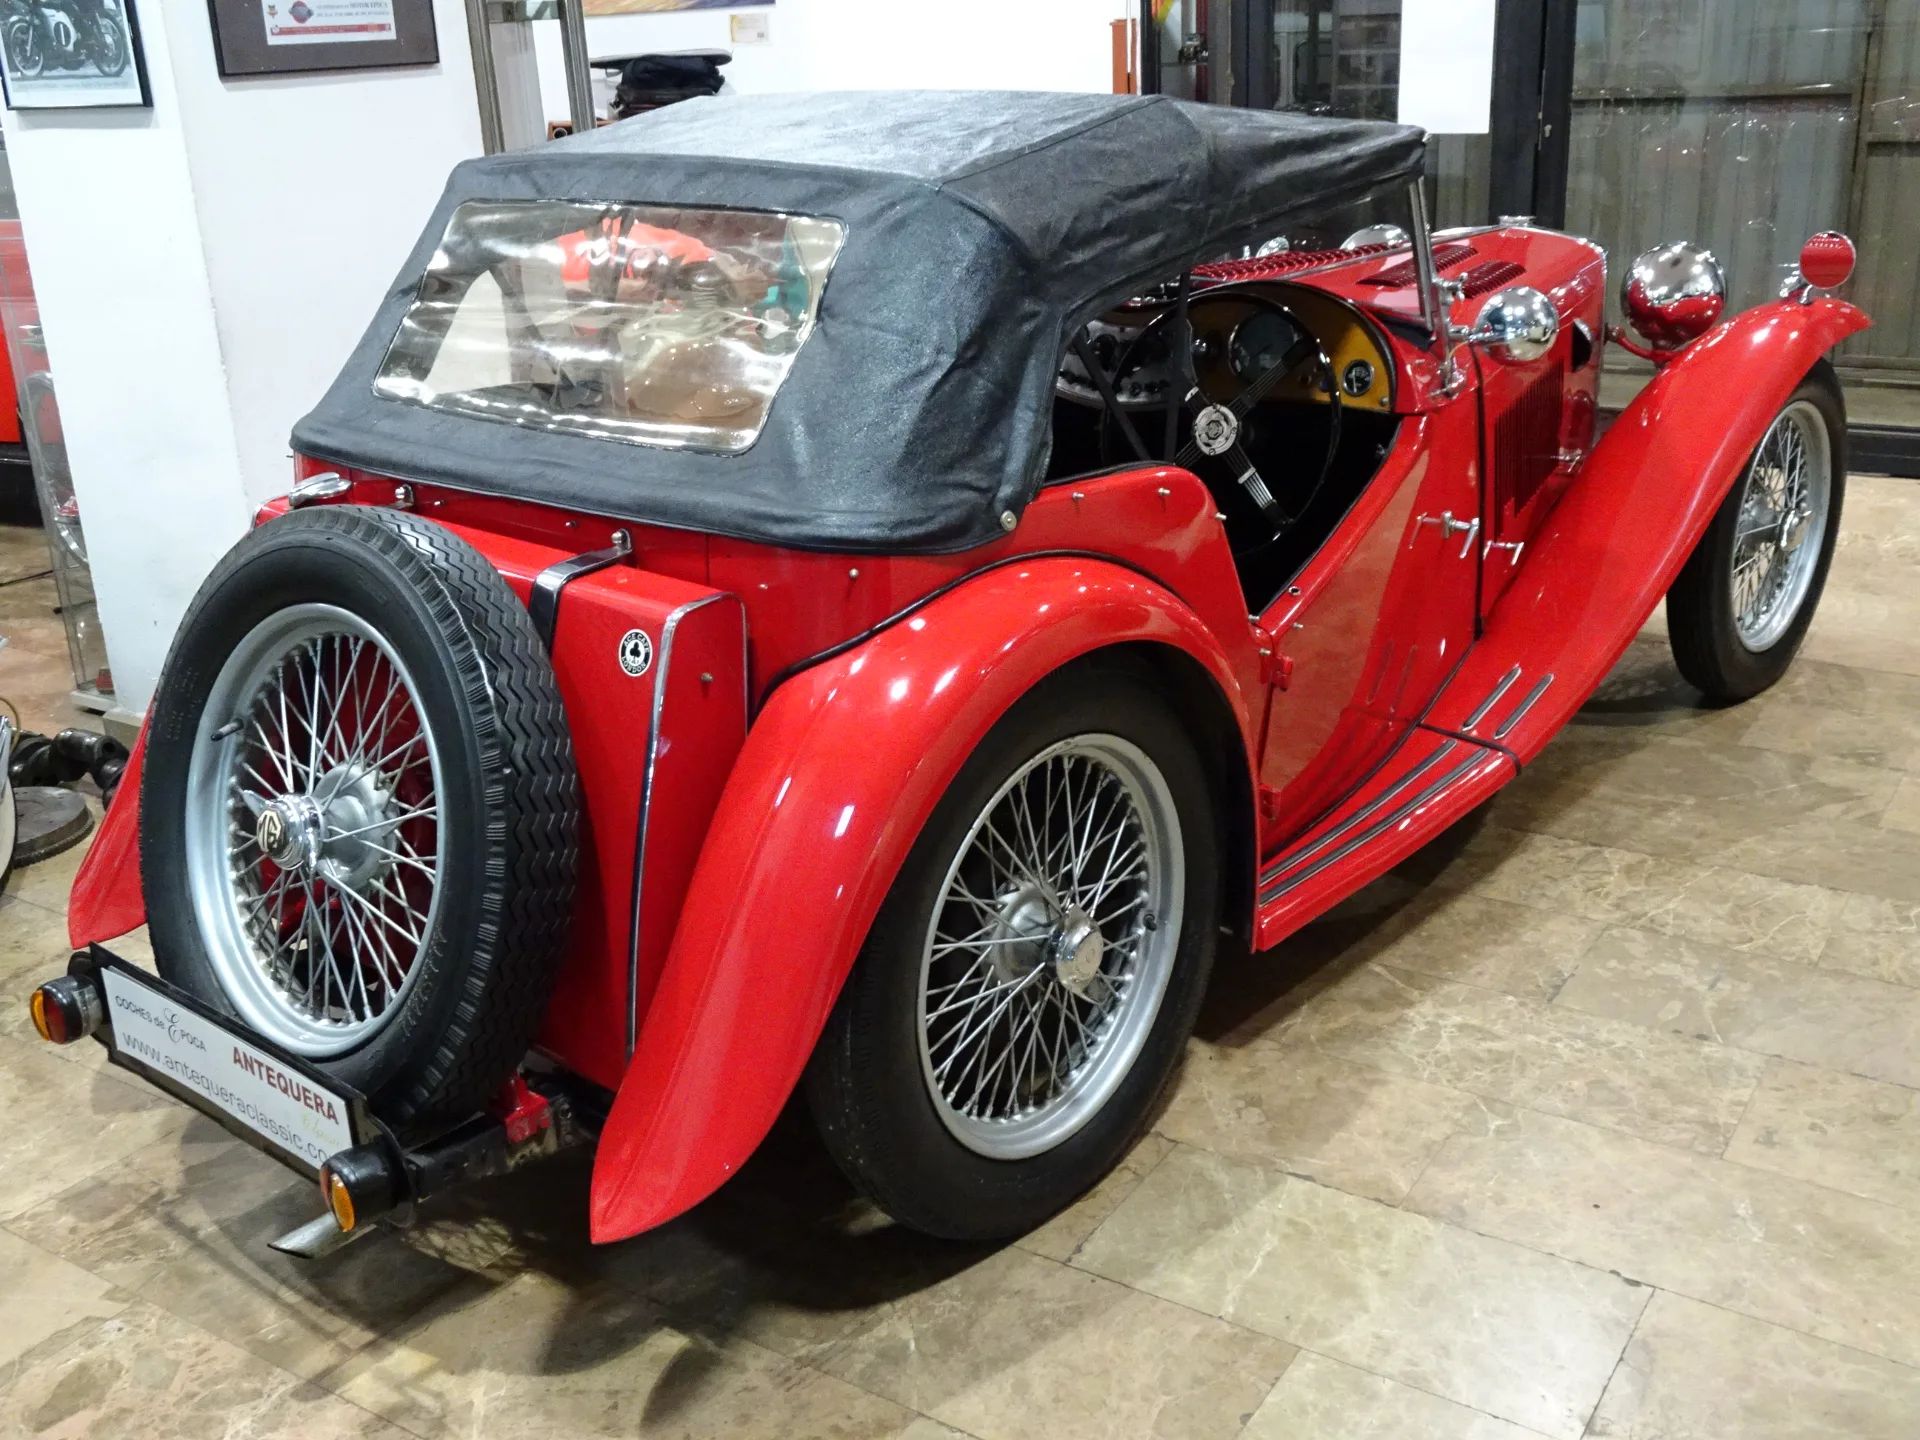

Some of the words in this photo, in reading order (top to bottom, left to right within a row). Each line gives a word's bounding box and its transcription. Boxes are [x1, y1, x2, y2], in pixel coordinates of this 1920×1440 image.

[624, 633, 636, 647] ACE
[637, 634, 650, 653] CAFE
[621, 655, 647, 673] LONDON
[256, 809, 282, 852] MG
[115, 995, 153, 1023] COCHES
[122, 1032, 330, 1163] www.antequeraclassic.co
[233, 1046, 339, 1125] ANTEQUERA
